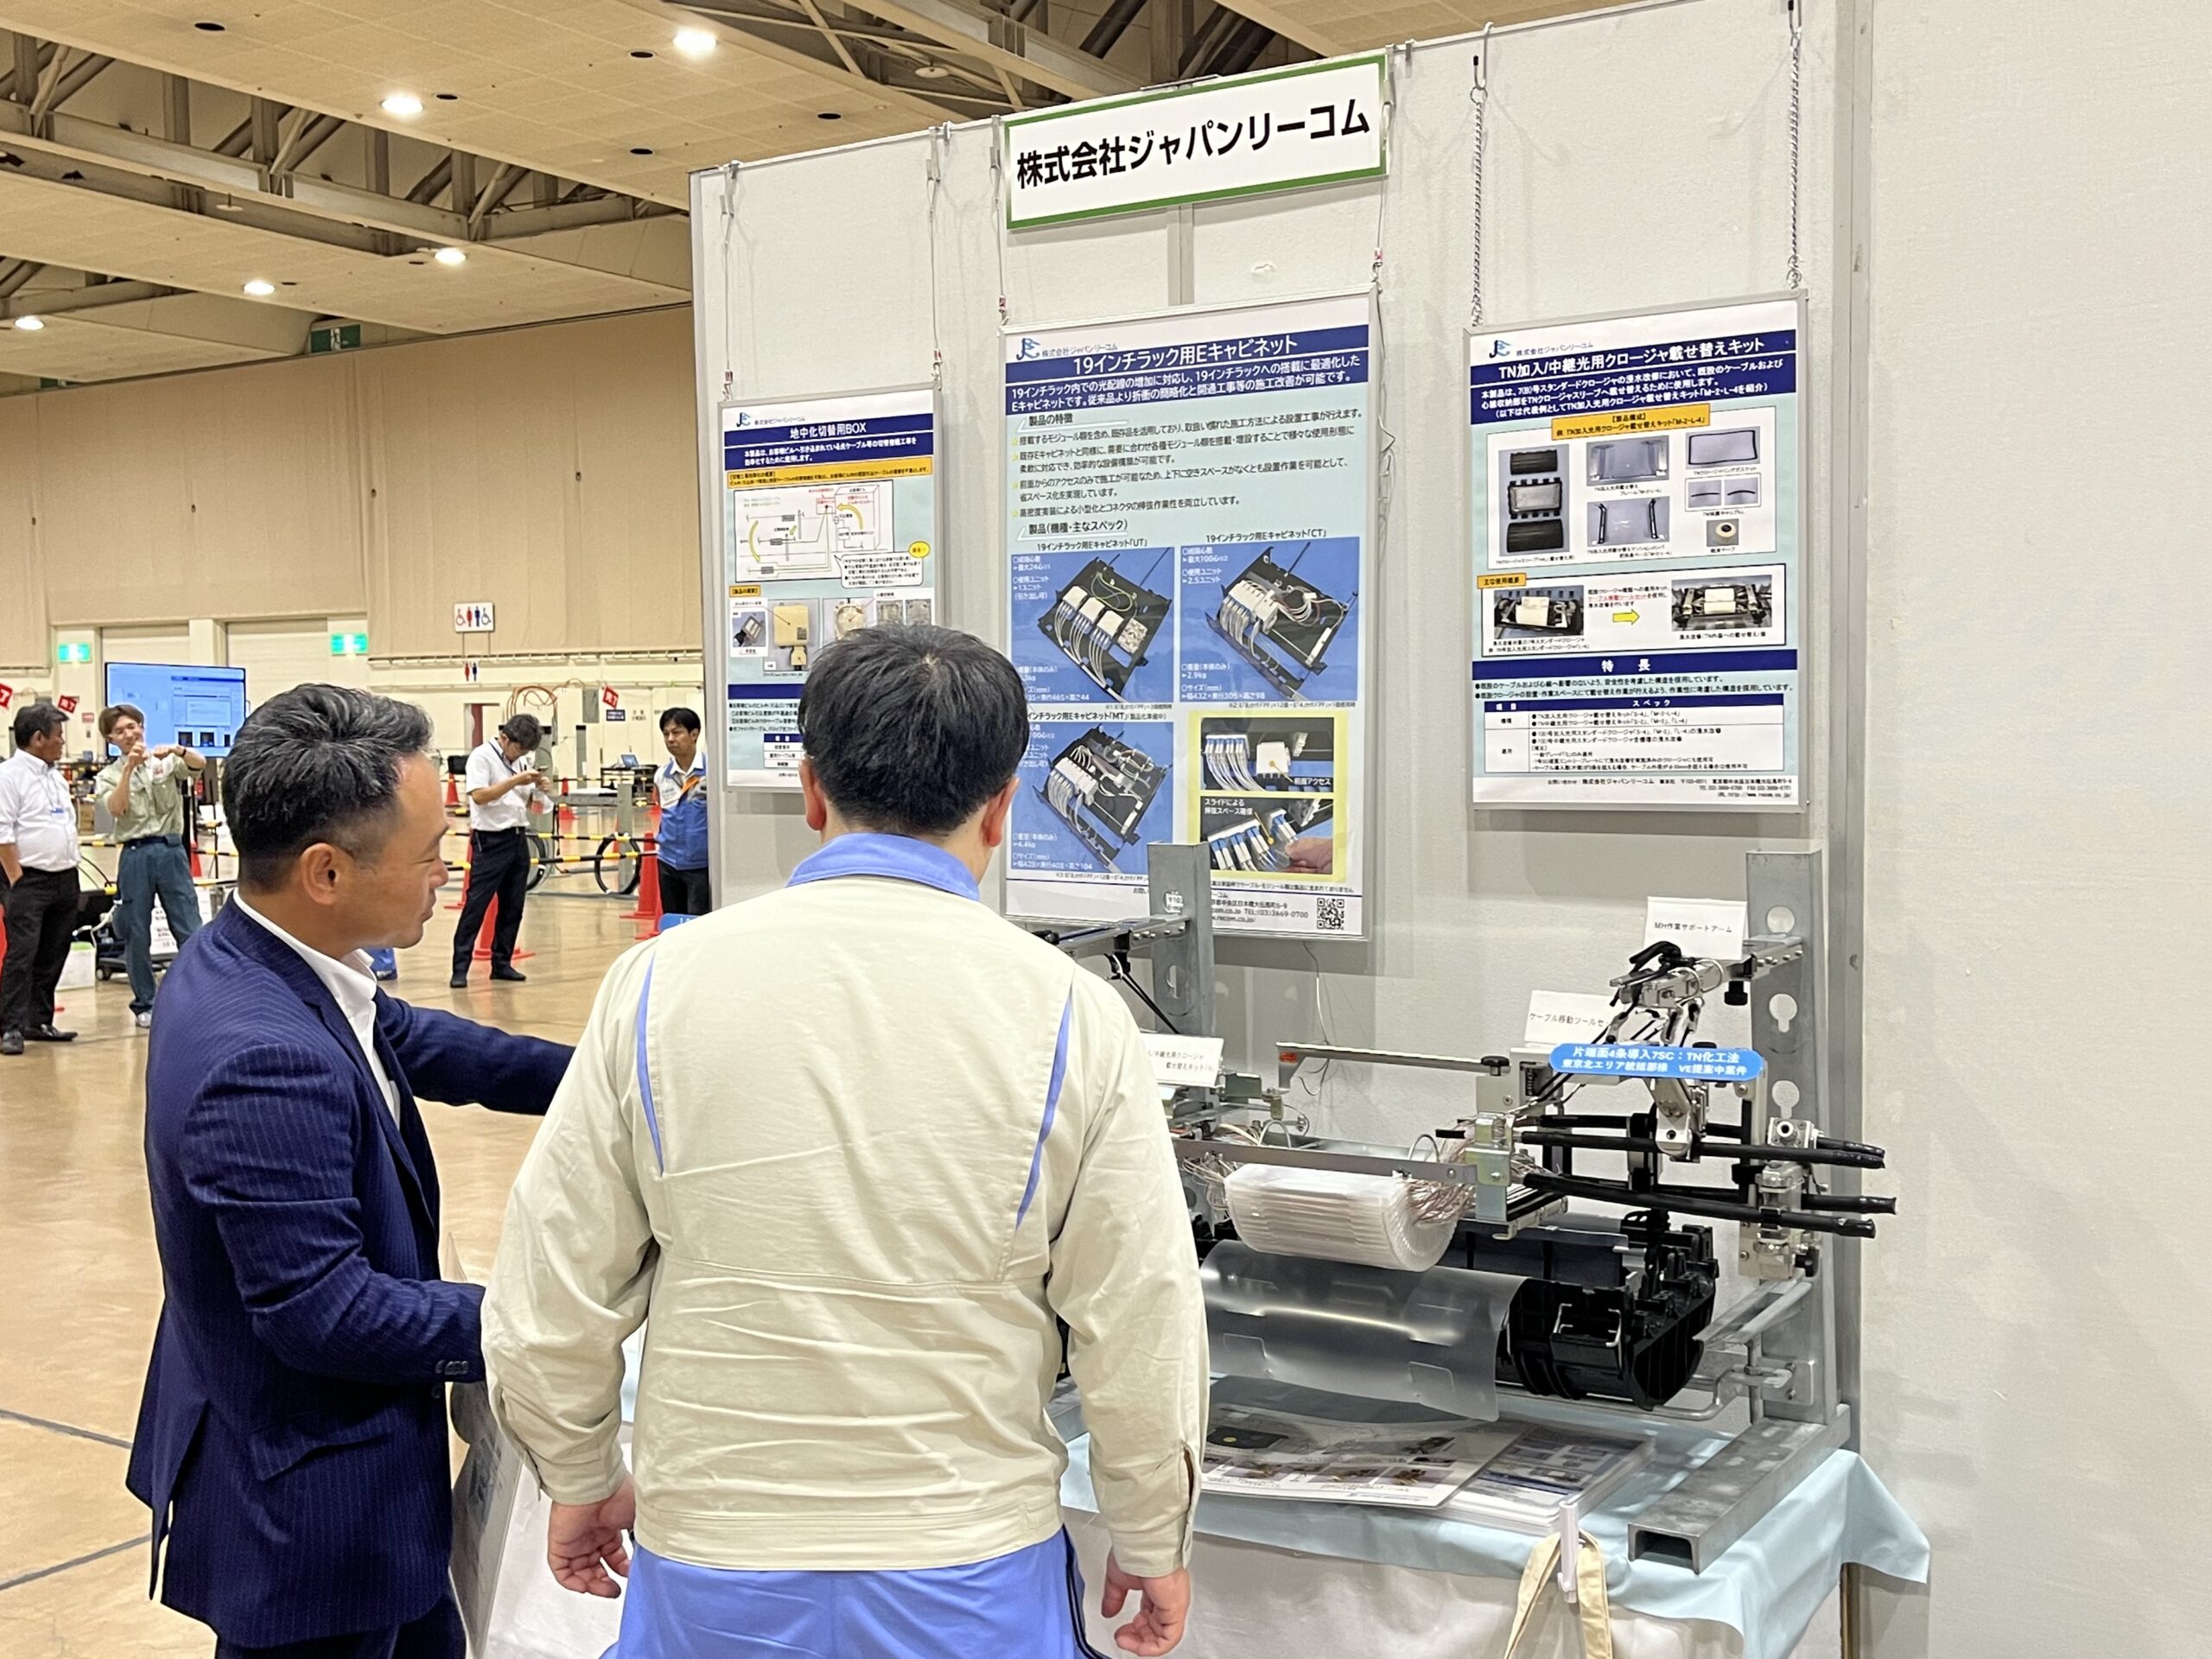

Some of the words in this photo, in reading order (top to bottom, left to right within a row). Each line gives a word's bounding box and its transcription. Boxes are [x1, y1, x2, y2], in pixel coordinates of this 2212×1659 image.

[1017, 99, 1370, 189] 株式会社ジャパンリーコム
[1042, 343, 1118, 359] 株式会社ジャパンリーコム
[1073, 334, 1298, 375] 19インチラック用Eキャビネット
[1516, 342, 1594, 357] 株式会社ジャパンリーコム
[1498, 337, 1764, 379] TN加入/中継光用クロージャ載せ替えキット
[1029, 413, 1073, 427] 製品の特徴
[790, 423, 867, 439] 地中化切替用BOX
[1601, 659, 1614, 673] 特
[1638, 658, 1651, 672] 長
[1529, 1013, 1609, 1027] ケーブル移動ツールセ
